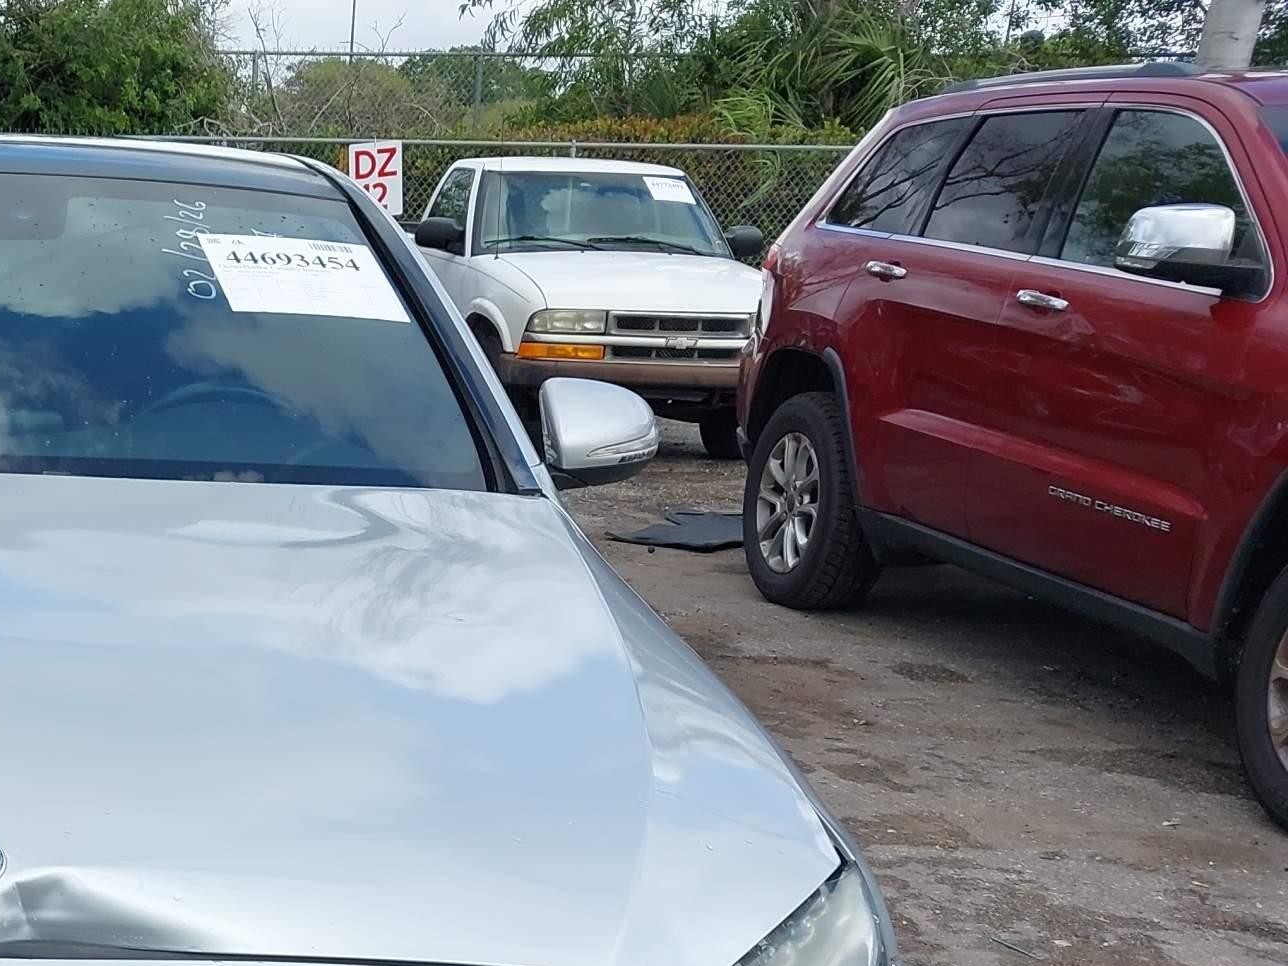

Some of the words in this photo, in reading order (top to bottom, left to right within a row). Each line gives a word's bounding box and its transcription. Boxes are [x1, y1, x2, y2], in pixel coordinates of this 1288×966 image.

[355, 147, 398, 180] DZ
[226, 250, 361, 272] 44693454
[1048, 485, 1092, 506] GRAND
[1095, 500, 1171, 532] CHEROKEE
